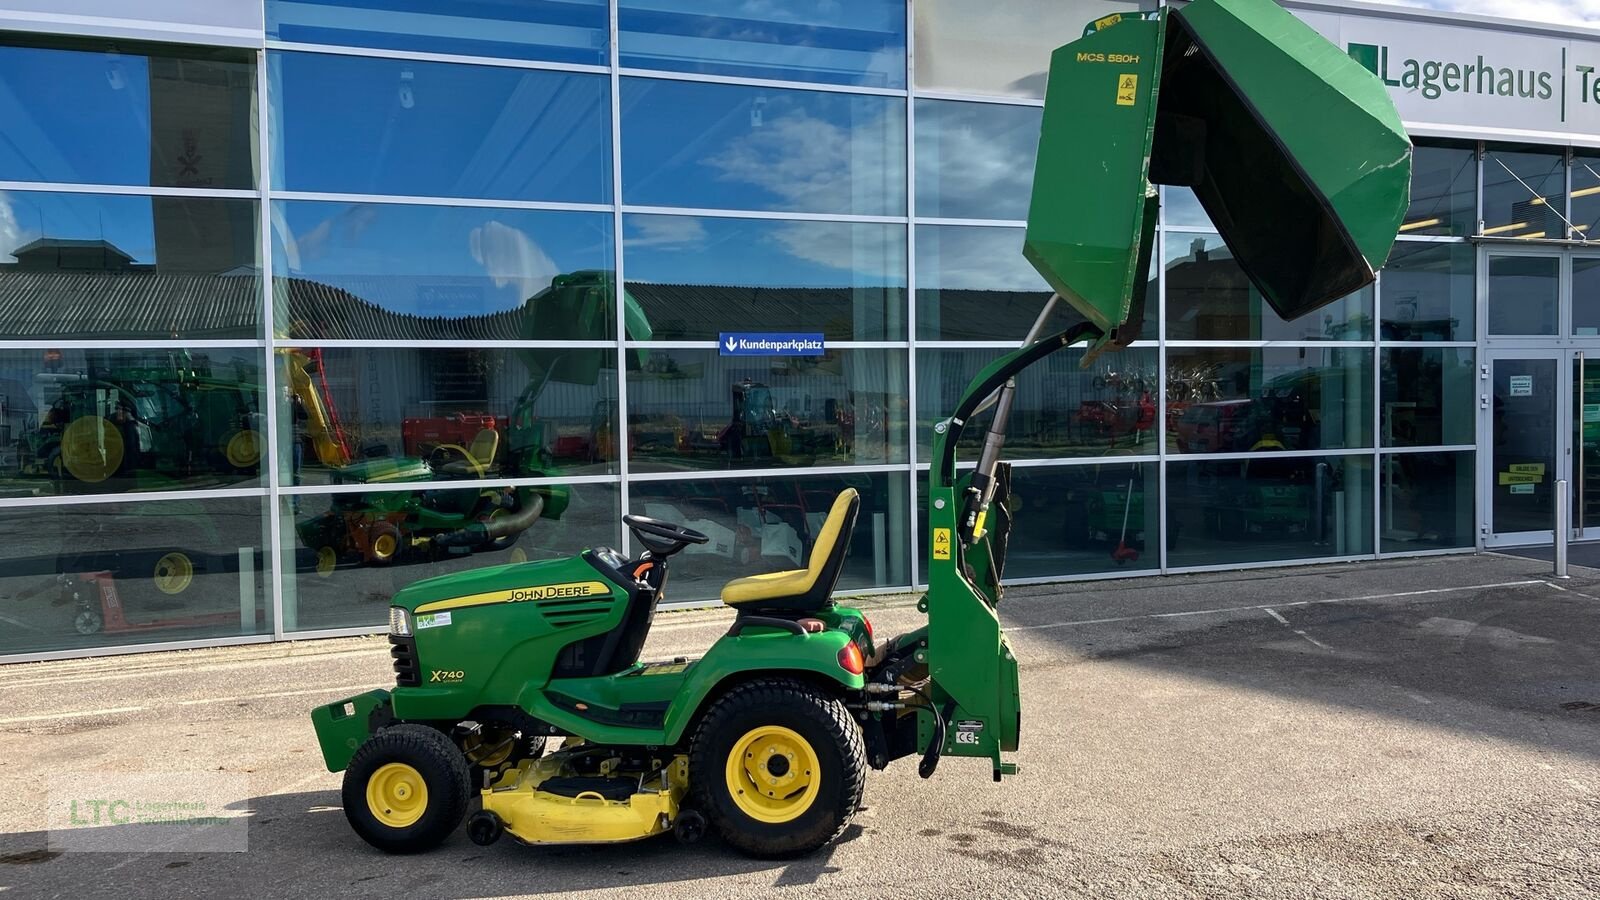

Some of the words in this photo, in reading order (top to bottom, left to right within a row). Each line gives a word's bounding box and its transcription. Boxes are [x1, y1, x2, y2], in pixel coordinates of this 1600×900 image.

[1076, 52, 1105, 63] MCS
[1107, 53, 1140, 64] 580H
[1381, 46, 1552, 100] Lagerhaus
[739, 338, 823, 353] Kundenparkplatz
[506, 589, 544, 602] JOHN
[546, 586, 591, 599] DEERE
[429, 669, 465, 682] X740
